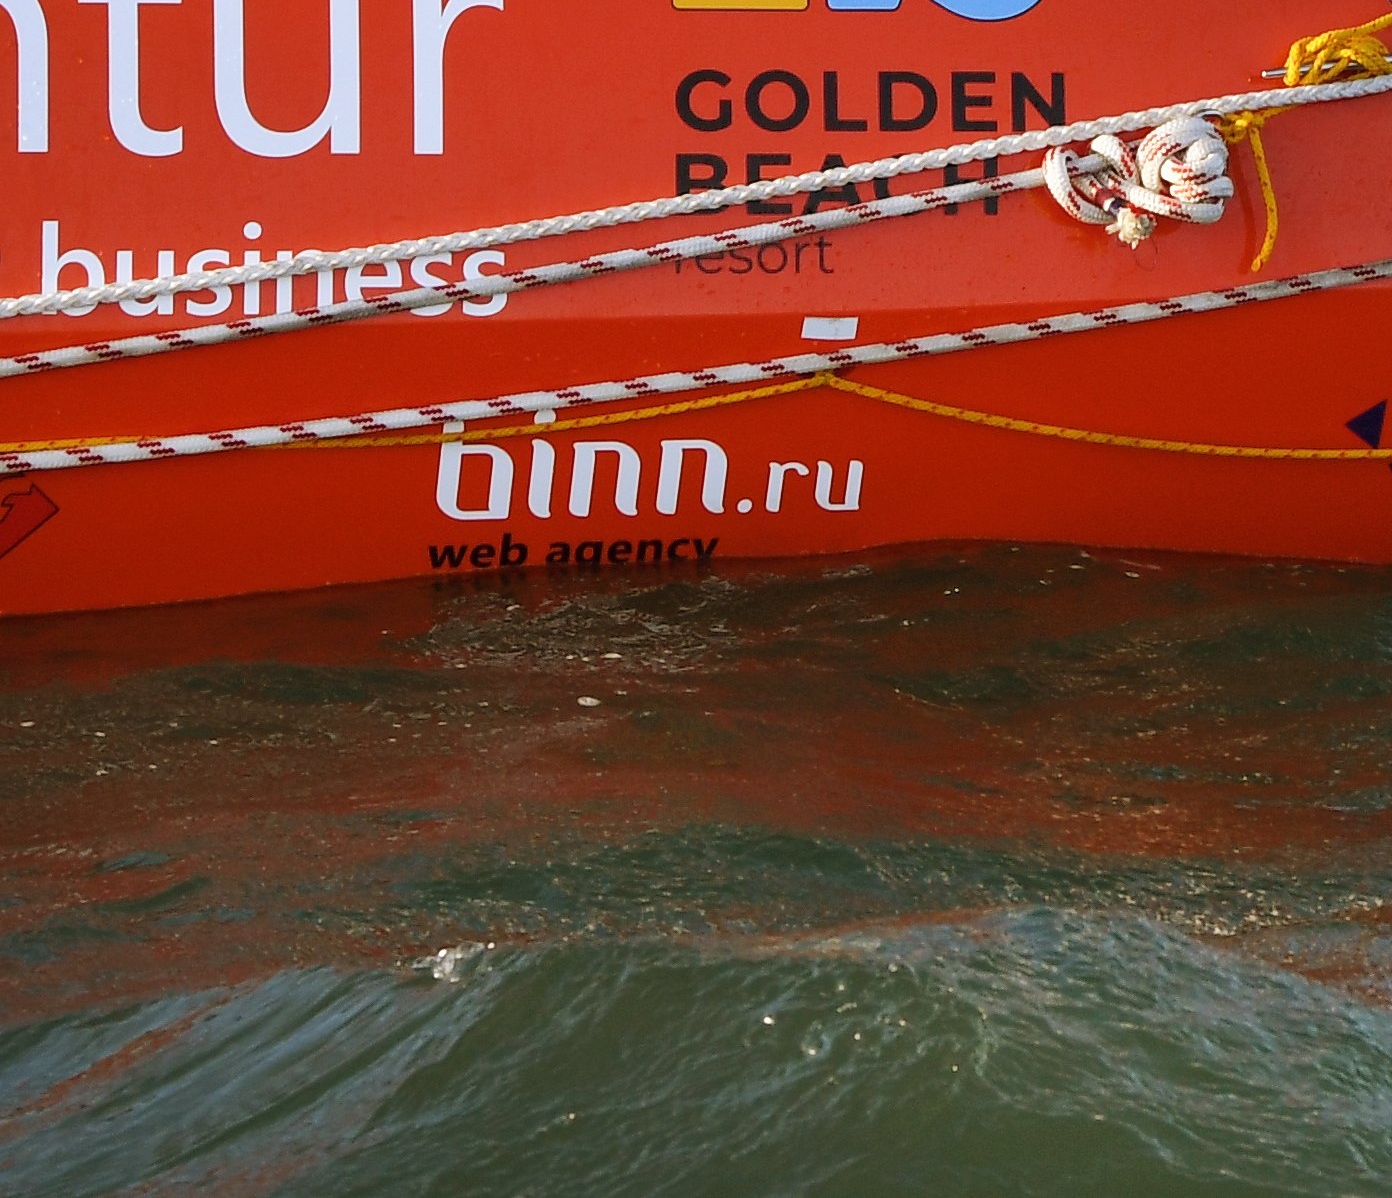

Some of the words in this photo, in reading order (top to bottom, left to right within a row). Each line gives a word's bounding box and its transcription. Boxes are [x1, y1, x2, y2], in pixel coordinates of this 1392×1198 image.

[674, 68, 1067, 132] GOLDEN
[41, 220, 509, 317] business
[436, 409, 864, 520] binn.ru
[427, 532, 529, 569] web
